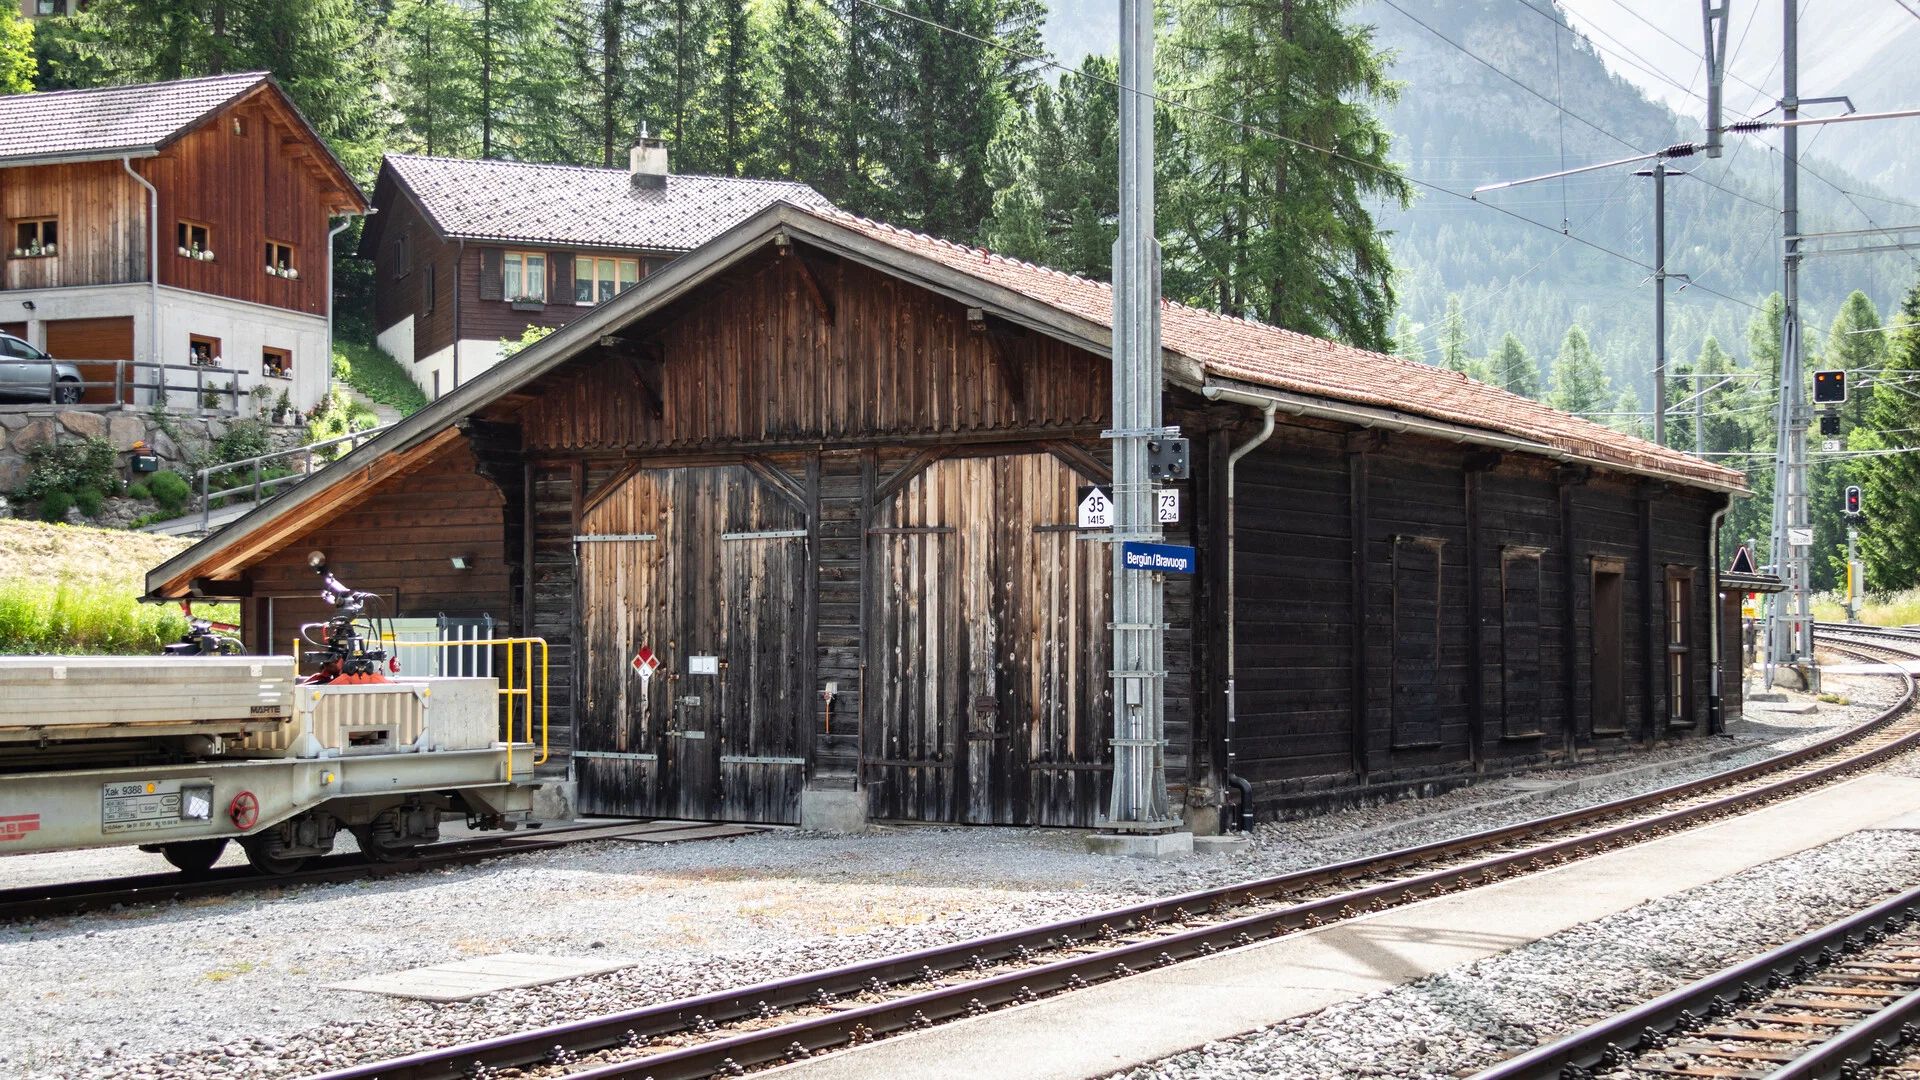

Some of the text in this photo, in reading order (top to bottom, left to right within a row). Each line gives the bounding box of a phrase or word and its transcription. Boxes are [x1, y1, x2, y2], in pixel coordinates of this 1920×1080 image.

[1088, 496, 1104, 512] 35
[1161, 495, 1176, 507] 73
[1087, 515, 1105, 525] 1415
[250, 705, 280, 713] MARTE
[105, 785, 142, 796] Xak 9388
